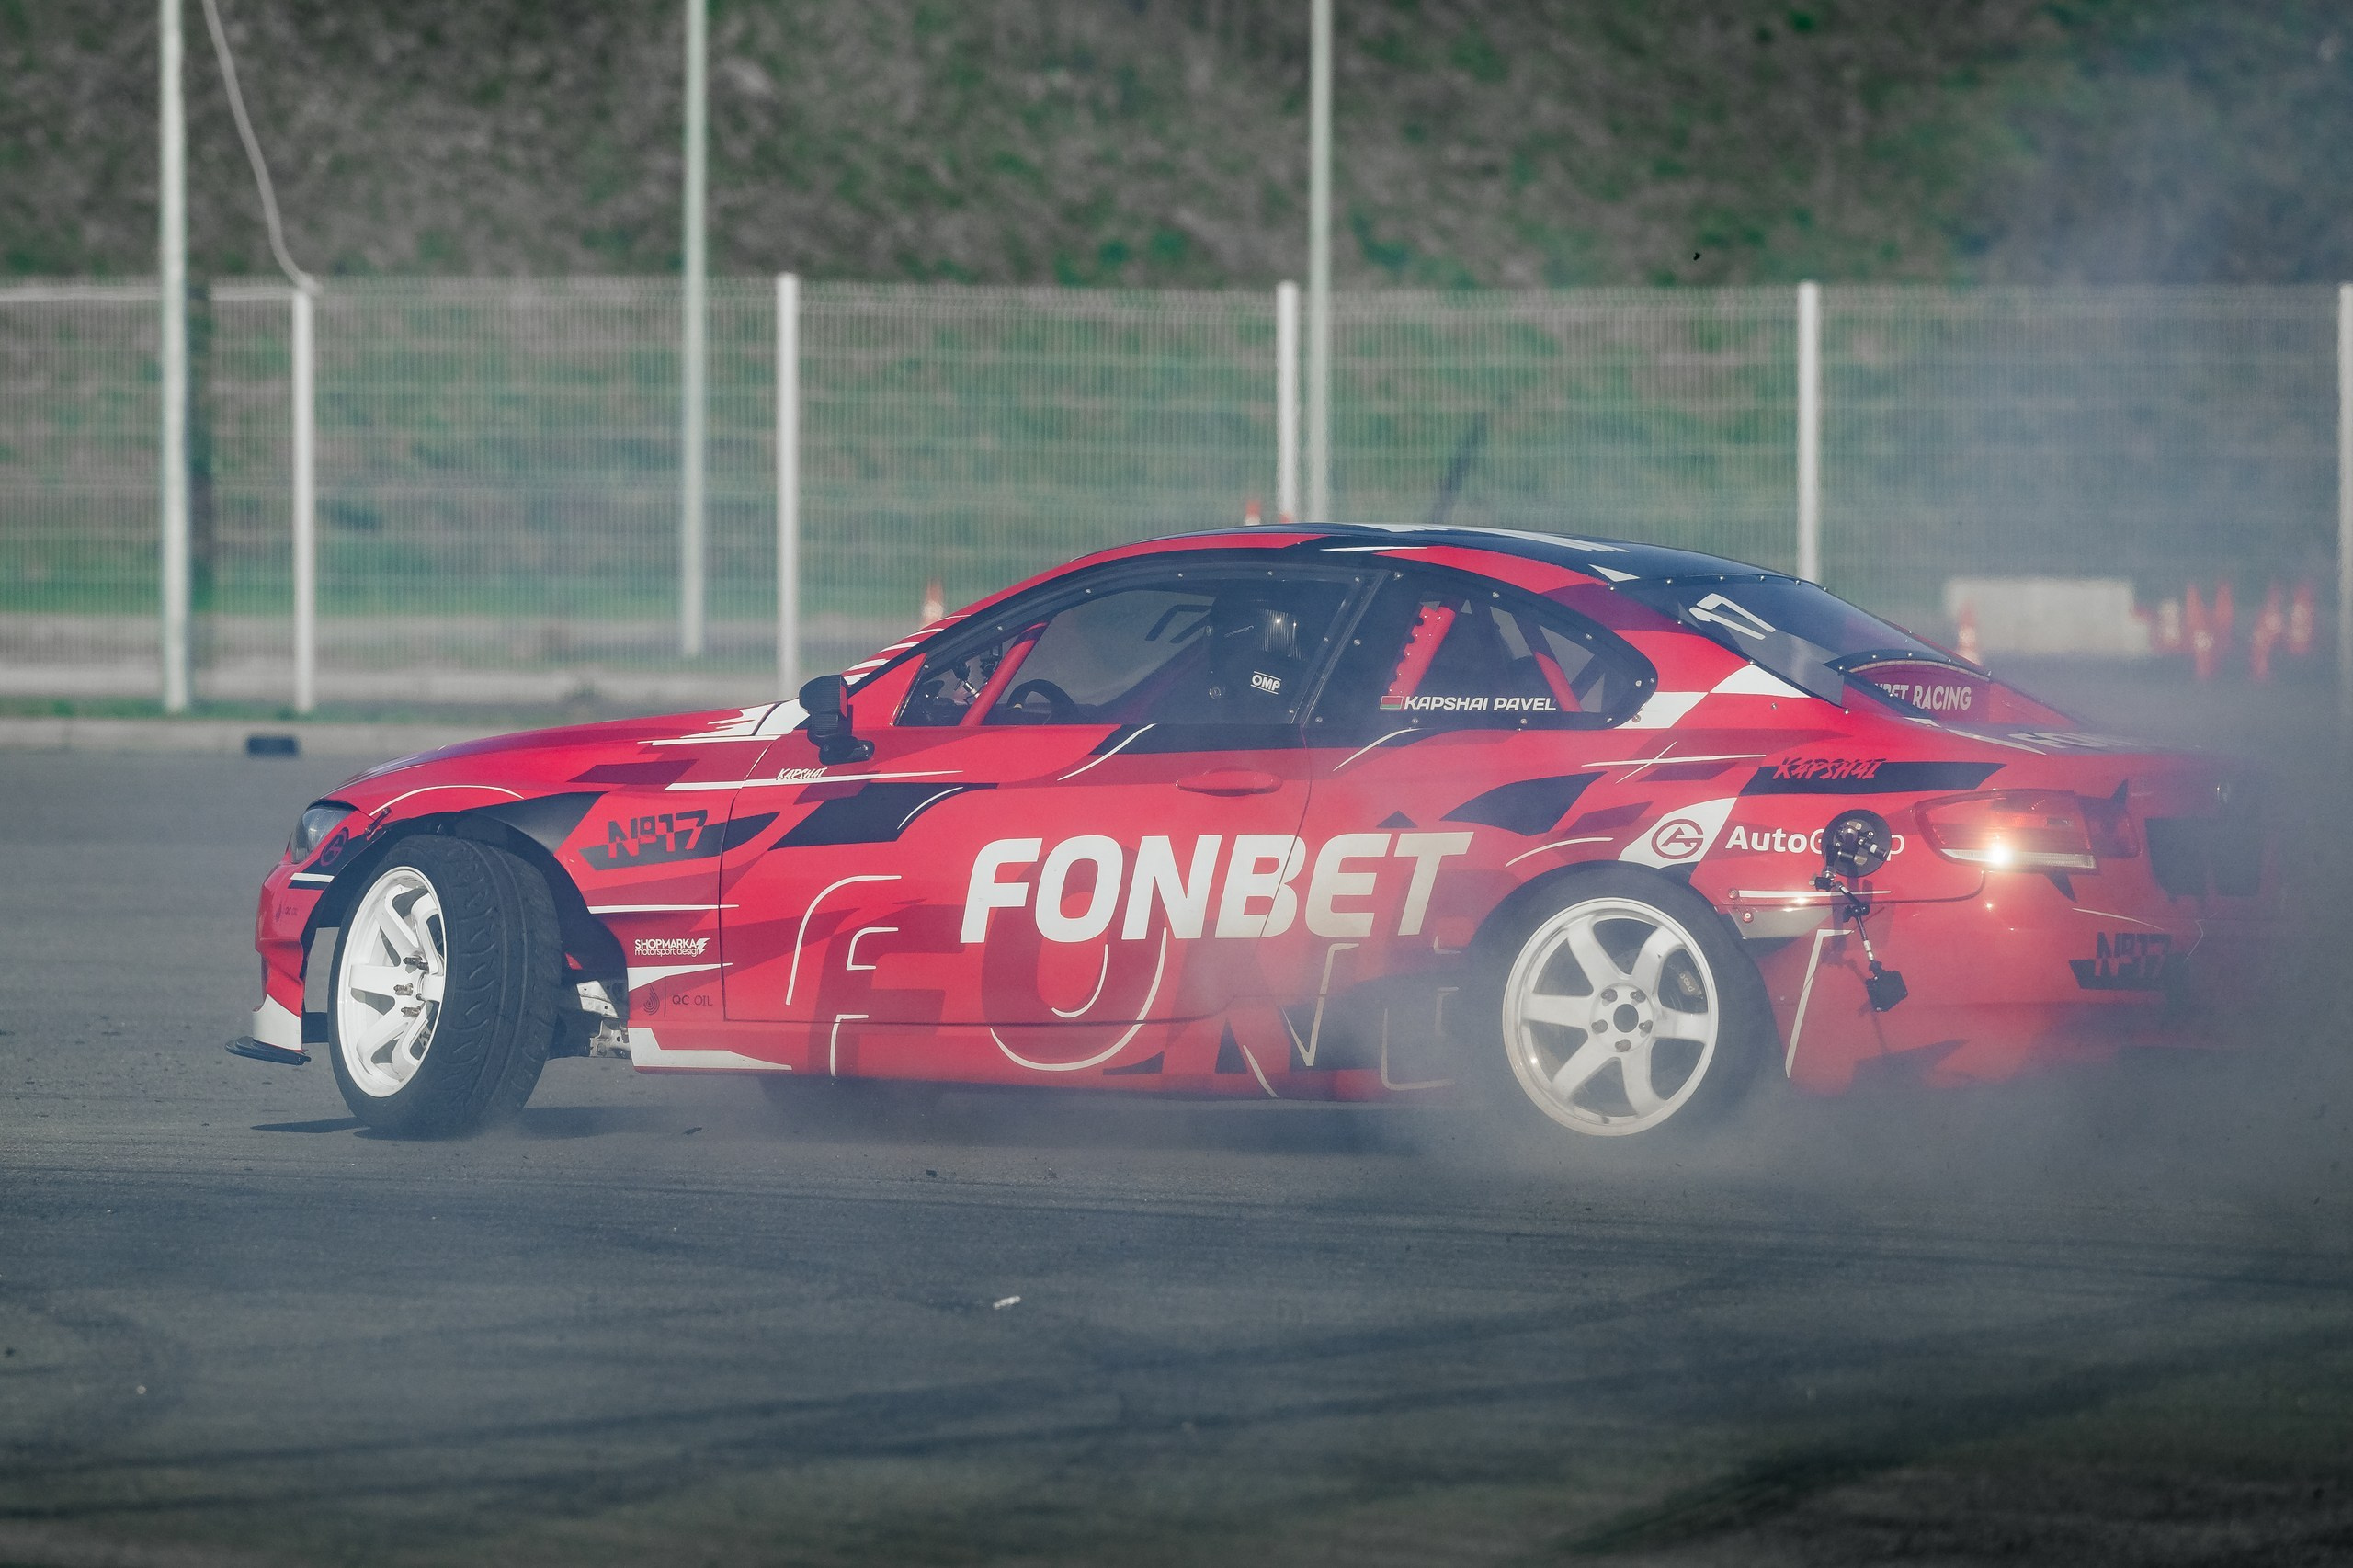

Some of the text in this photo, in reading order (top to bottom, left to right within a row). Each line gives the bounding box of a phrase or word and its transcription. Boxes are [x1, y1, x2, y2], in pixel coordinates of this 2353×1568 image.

[1251, 674, 1280, 691] OMP
[1404, 696, 1556, 710] KAPSHAI PAVEL
[1913, 685, 1972, 710] RACING
[1772, 758, 1887, 779] KAPSHAI
[960, 831, 1474, 944] FONBET
[634, 938, 697, 949] SHOPMARKA
[634, 949, 676, 957] motorsport
[672, 994, 713, 1006] QC OIL
